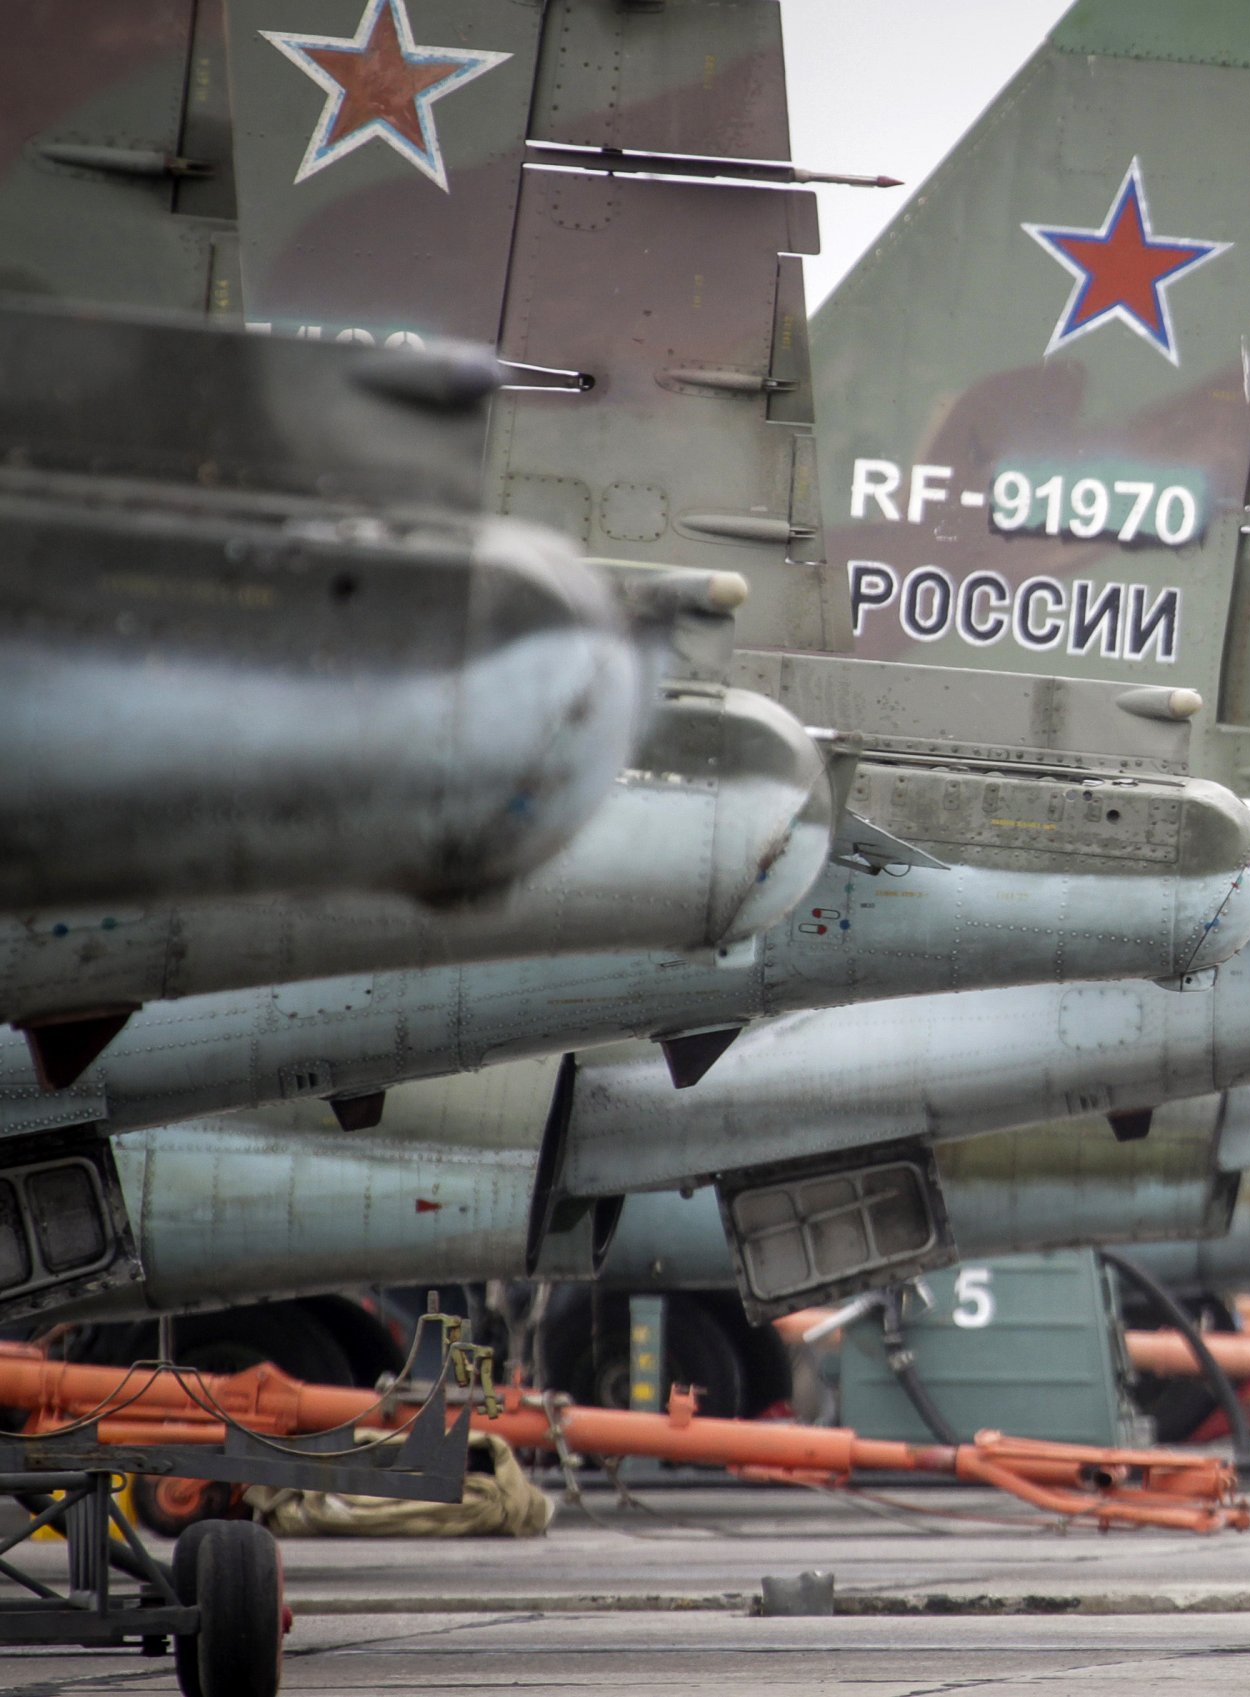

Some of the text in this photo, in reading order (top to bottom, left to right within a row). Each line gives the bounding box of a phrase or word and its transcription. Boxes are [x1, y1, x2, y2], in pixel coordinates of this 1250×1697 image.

[850, 458, 1196, 545] RF-91970
[847, 560, 1181, 663] РОССИИ
[952, 1268, 994, 1329] 5
